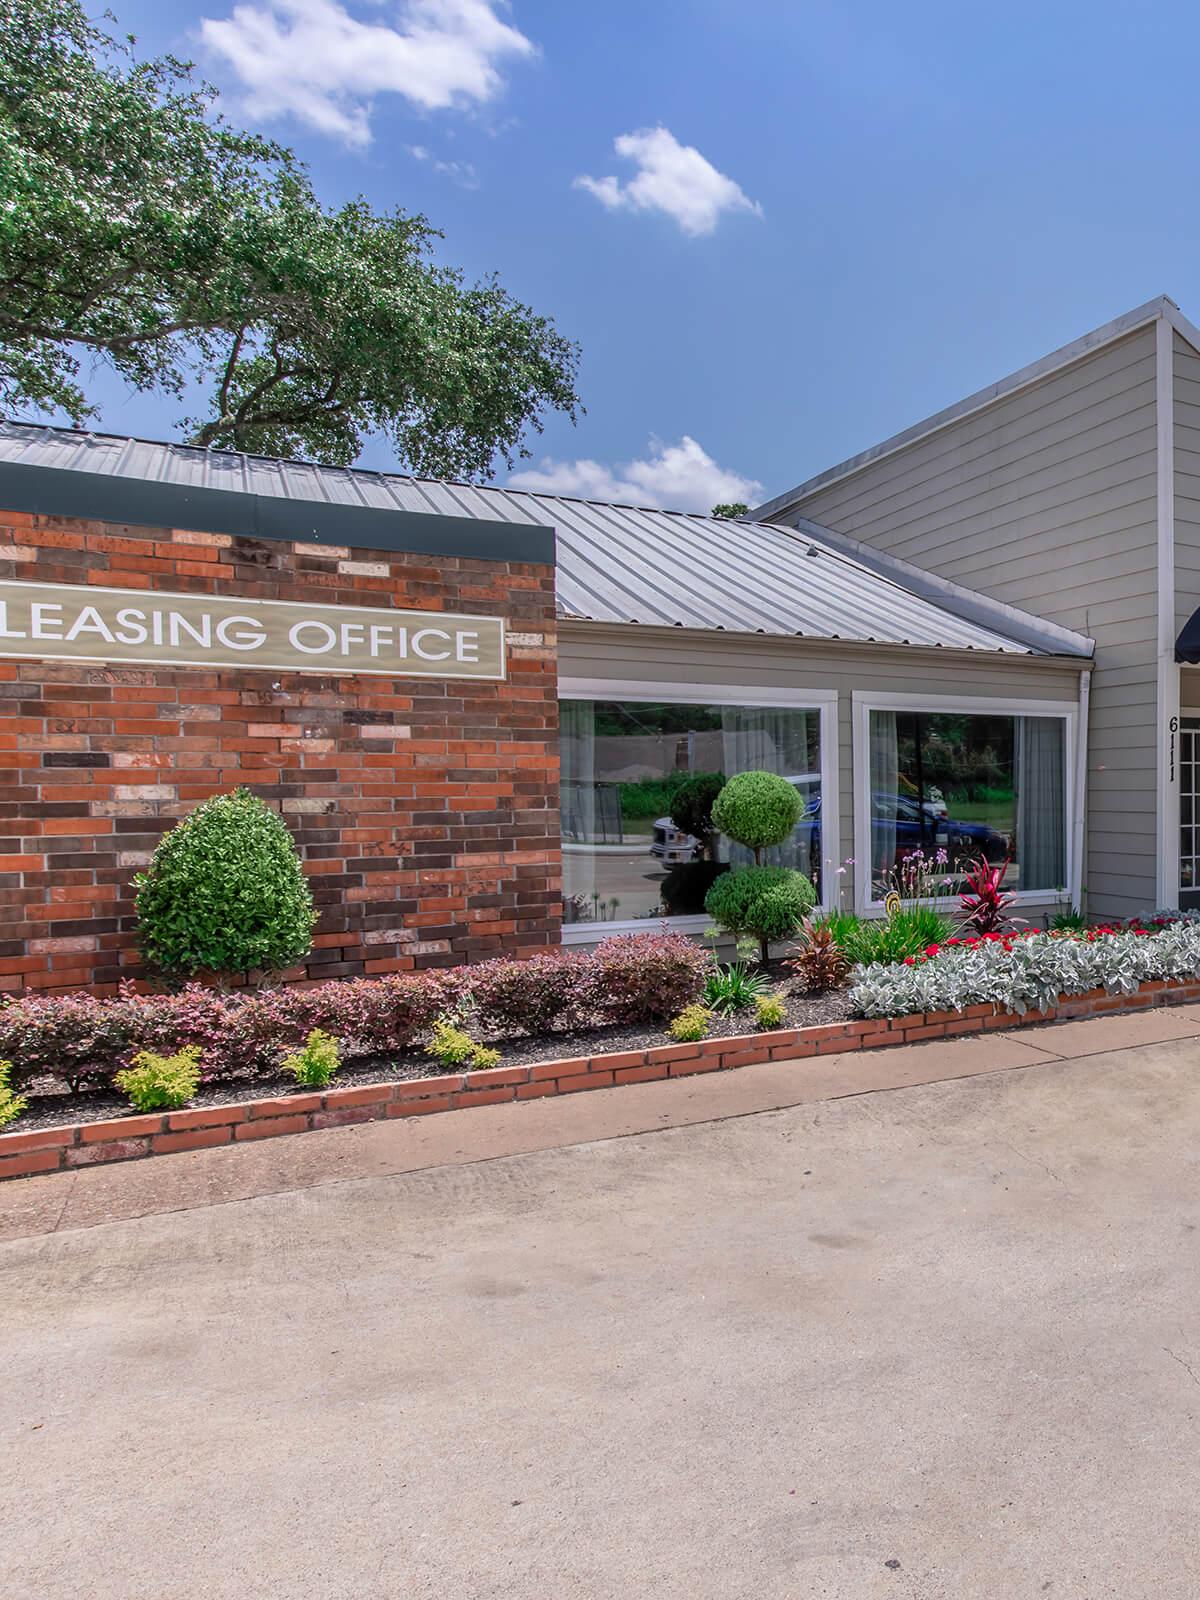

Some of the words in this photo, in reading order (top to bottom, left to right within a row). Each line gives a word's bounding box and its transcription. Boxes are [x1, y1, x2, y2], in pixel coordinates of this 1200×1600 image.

[0, 600, 267, 651] LEASING
[288, 620, 480, 663] OFFICE
[1169, 716, 1178, 782] 6111
